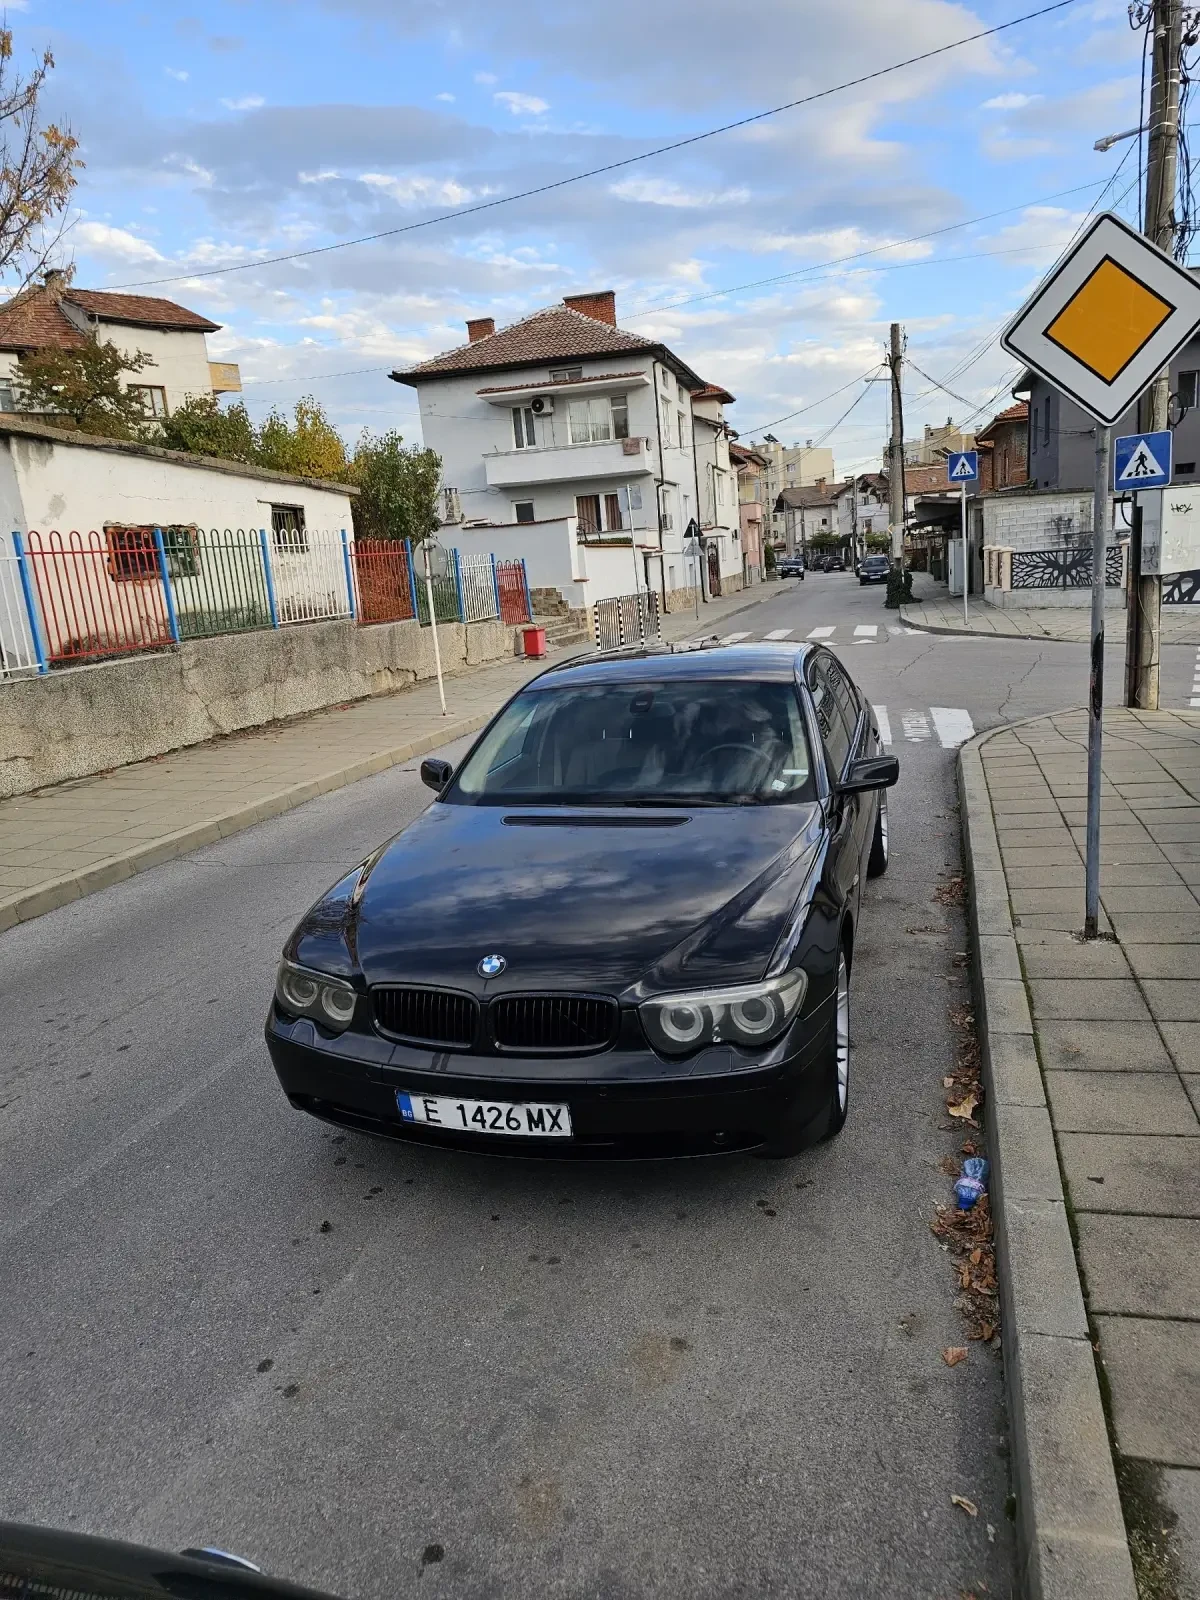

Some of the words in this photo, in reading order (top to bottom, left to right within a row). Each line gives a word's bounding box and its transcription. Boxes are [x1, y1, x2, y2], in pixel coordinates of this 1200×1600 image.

[402, 1109, 413, 1118] BG
[423, 1099, 442, 1124] E
[456, 1103, 521, 1131] 1426
[526, 1108, 563, 1132] MX
